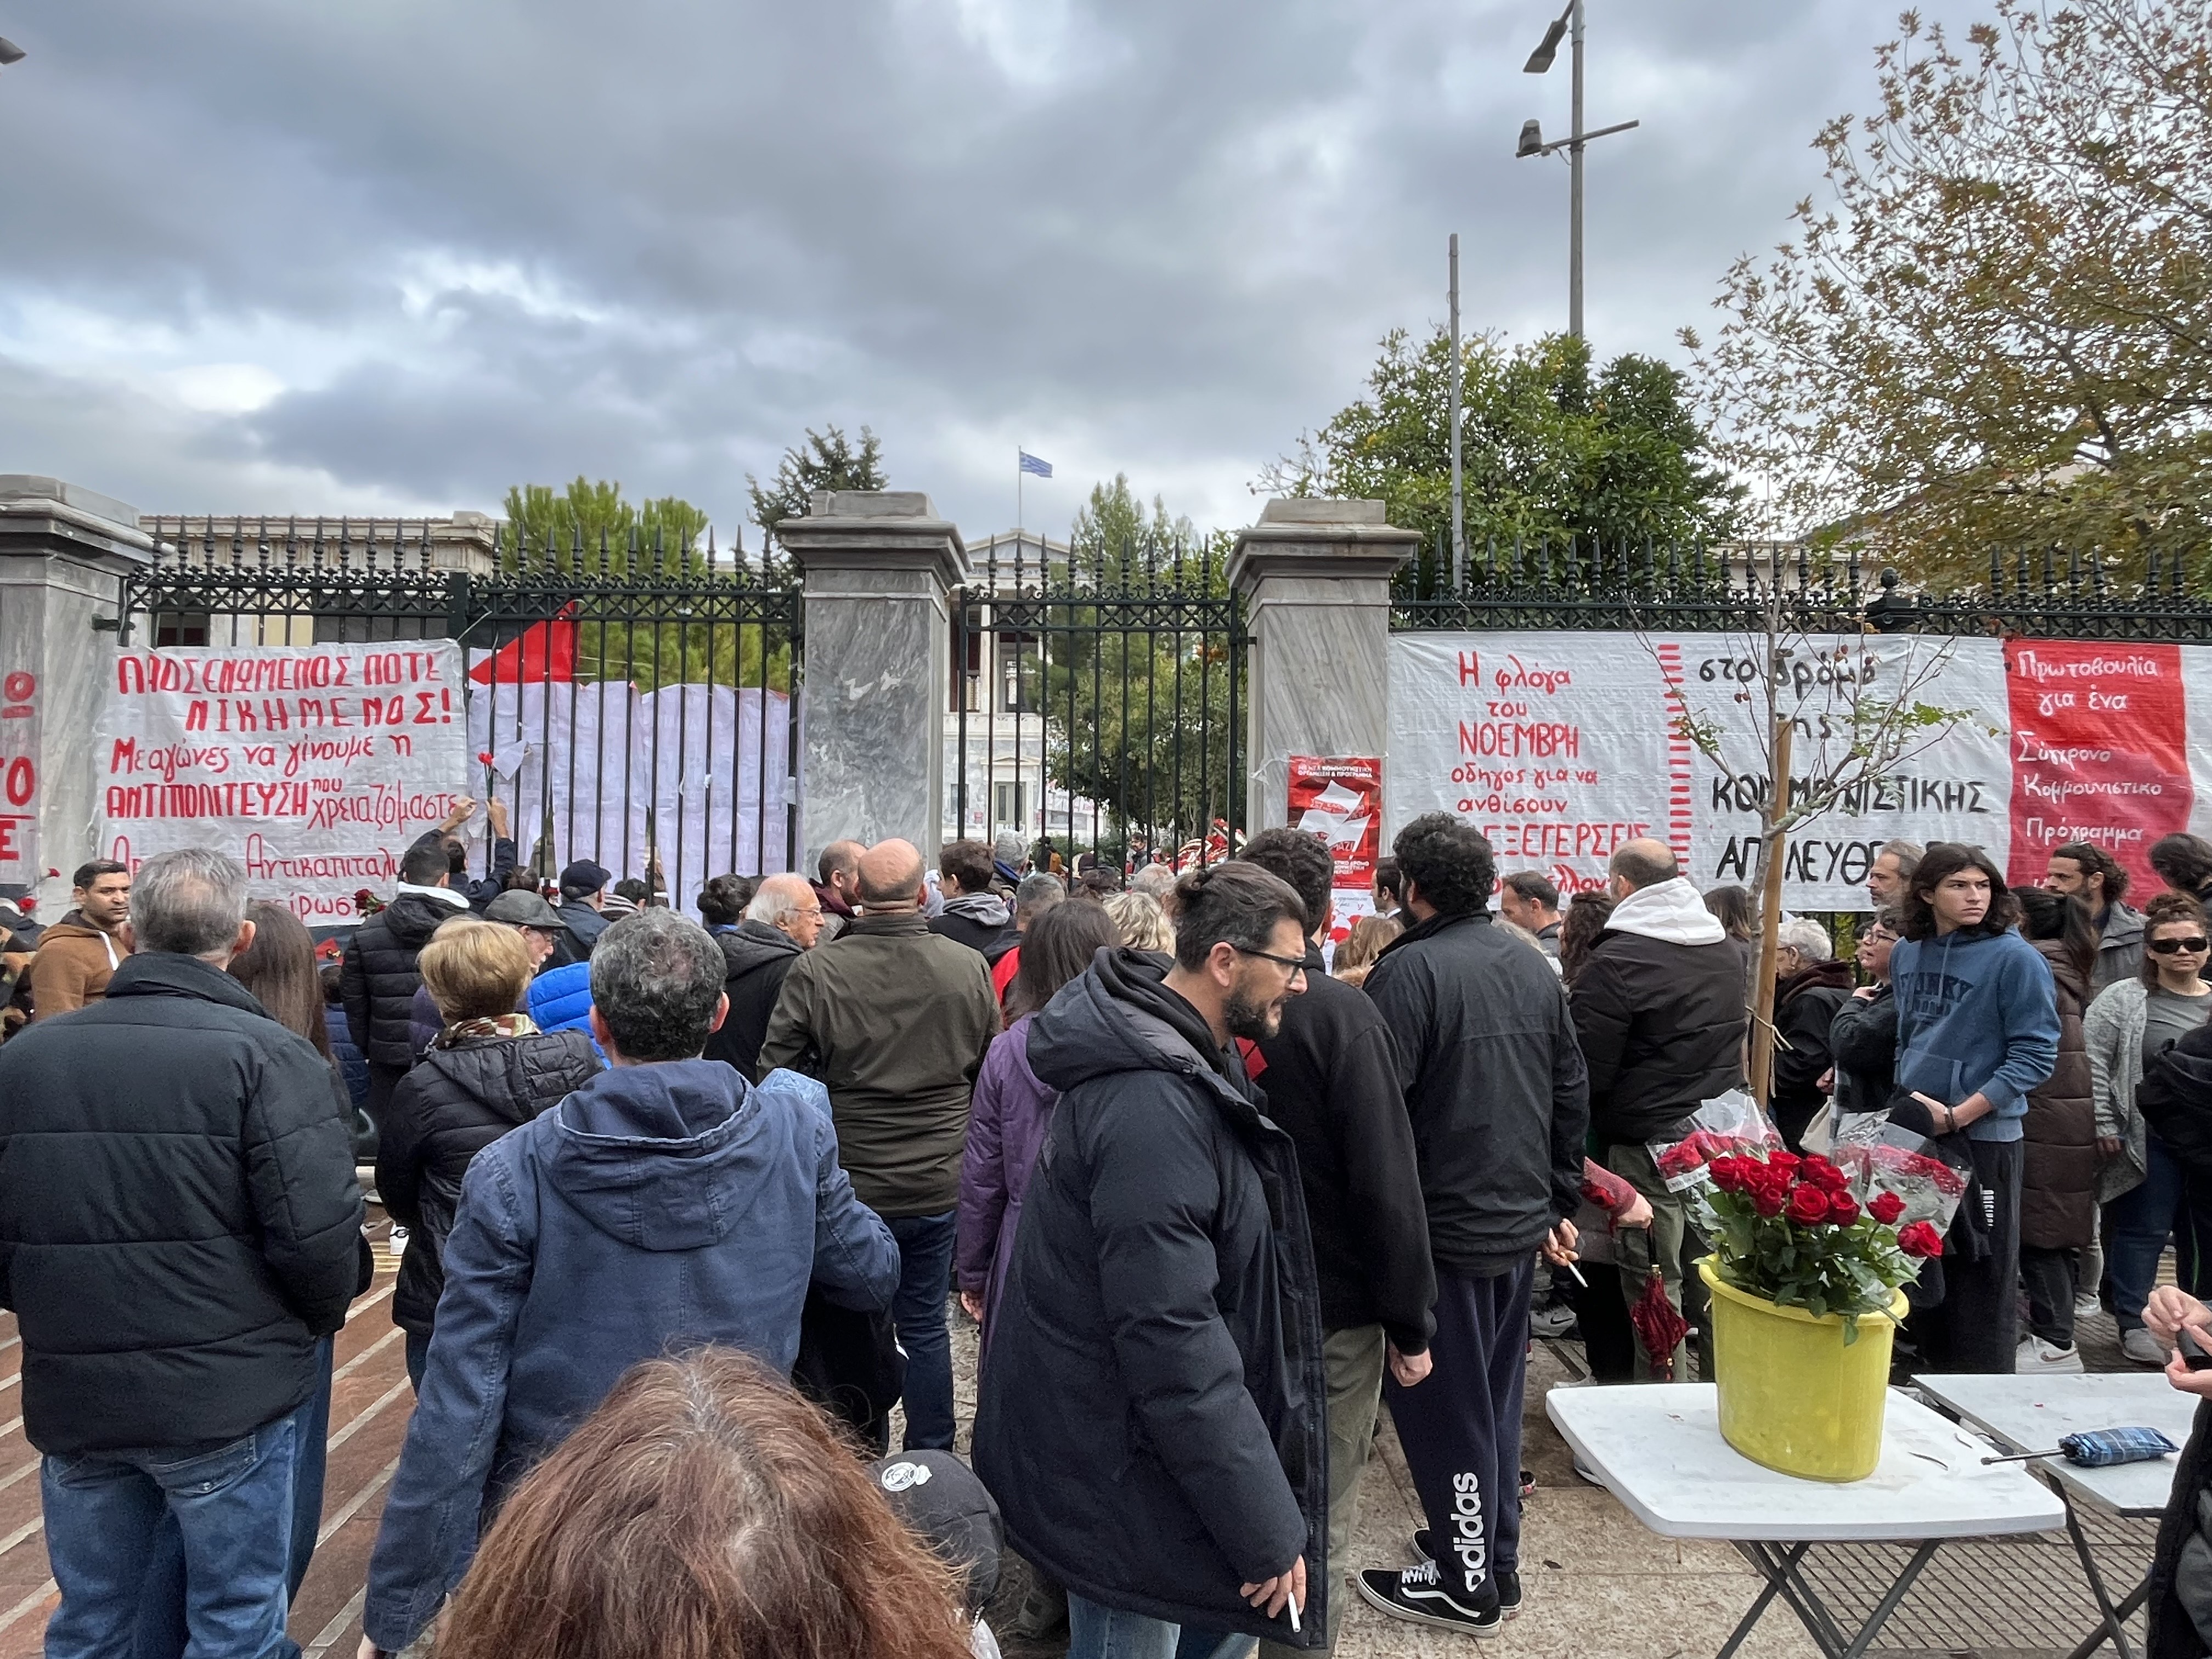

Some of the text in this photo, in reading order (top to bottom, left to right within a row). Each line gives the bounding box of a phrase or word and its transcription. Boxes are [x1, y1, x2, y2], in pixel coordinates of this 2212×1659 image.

[364, 651, 443, 686] ΠΟΤΕ
[1458, 651, 1571, 696] Η φλόγα
[1700, 658, 1757, 682] στο
[2017, 650, 2159, 683] Πρωτοβουλία
[1486, 701, 1527, 718] του
[2039, 684, 2129, 717] για ένα
[1459, 719, 1579, 759] ΝΟΕΜΒΡΗ
[1775, 713, 1831, 740] ης
[242, 745, 276, 766] να
[284, 733, 374, 777] γίνουμε
[387, 735, 411, 757] η
[2016, 730, 2112, 771] Σύγχρονο
[311, 778, 343, 793] που
[1451, 762, 1598, 791] οδηγός για να
[307, 778, 457, 835] χρειαζόμαστε
[1457, 792, 1568, 814] ανθίσουν
[246, 833, 399, 882] Αντικαπιταλι
[1451, 1471, 1486, 1593] adidas
